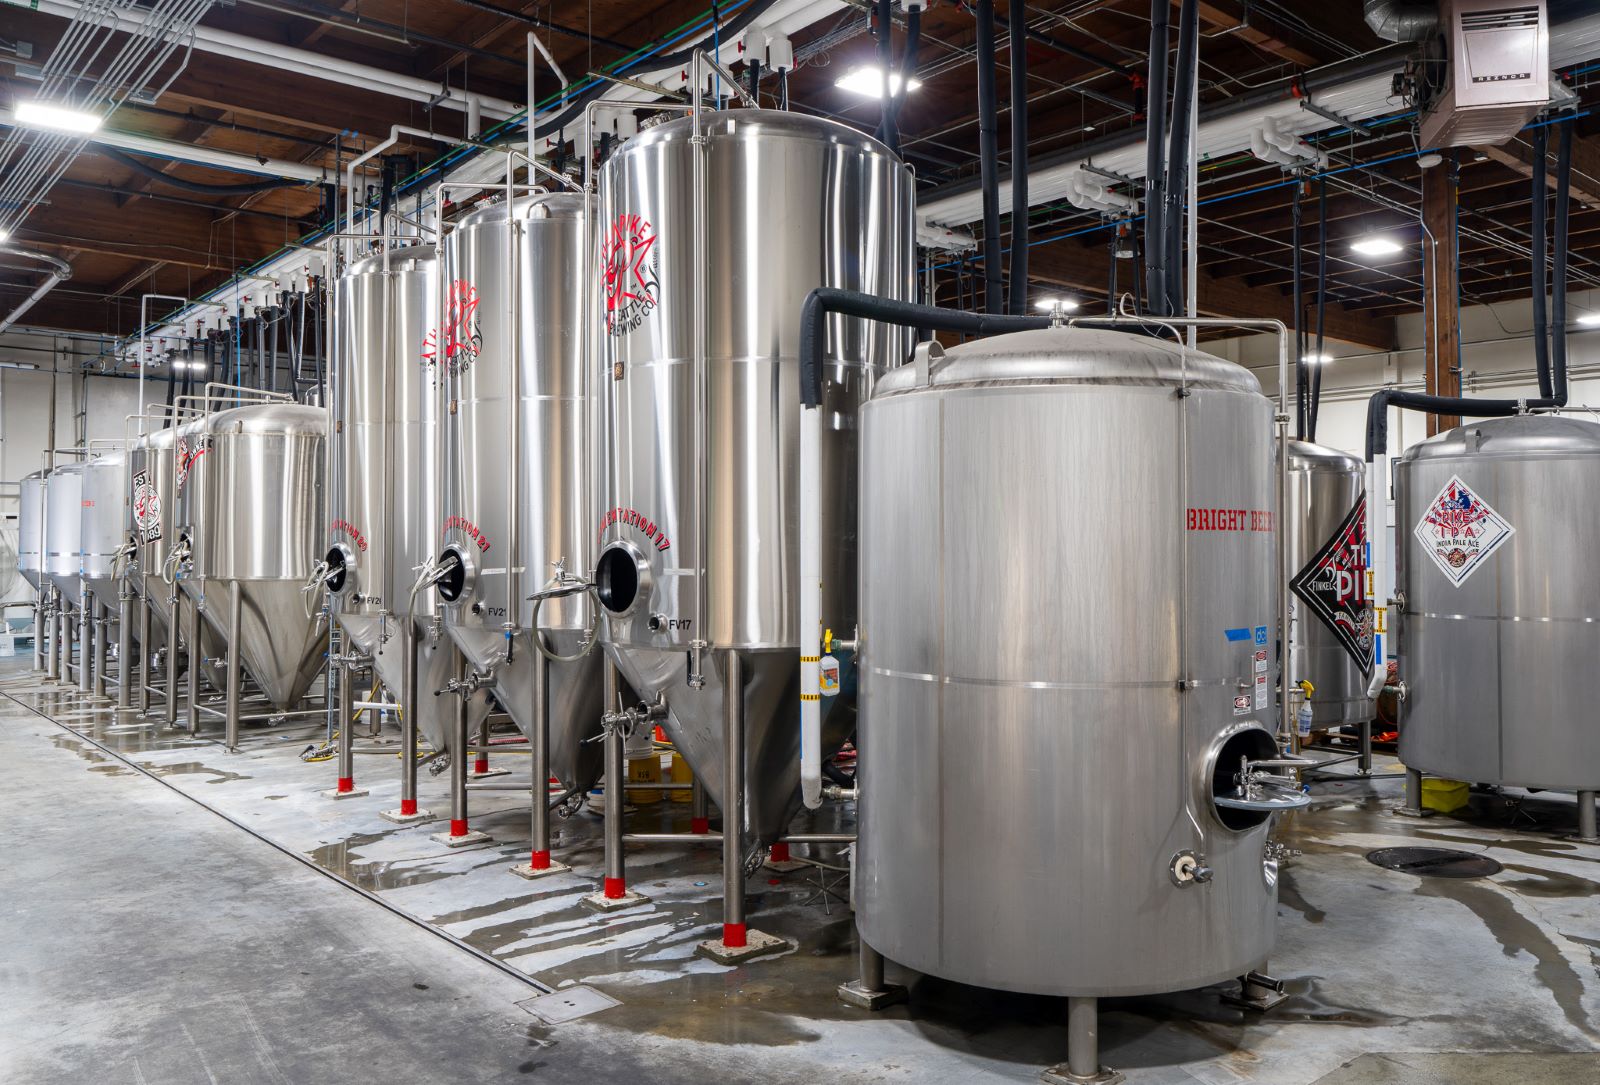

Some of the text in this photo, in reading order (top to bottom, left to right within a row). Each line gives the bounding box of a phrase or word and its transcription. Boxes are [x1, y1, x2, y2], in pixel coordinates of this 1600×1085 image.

[1478, 73, 1526, 82] REZNOR
[619, 213, 652, 240] PIKE
[1187, 508, 1247, 531] BRIGHT
[1443, 511, 1471, 524] PIKE
[140, 525, 161, 546] 189
[655, 532, 672, 552] 17
[1436, 538, 1480, 548] INDIA PALE ALE
[1350, 544, 1367, 566] TH
[669, 619, 692, 631] FV17
